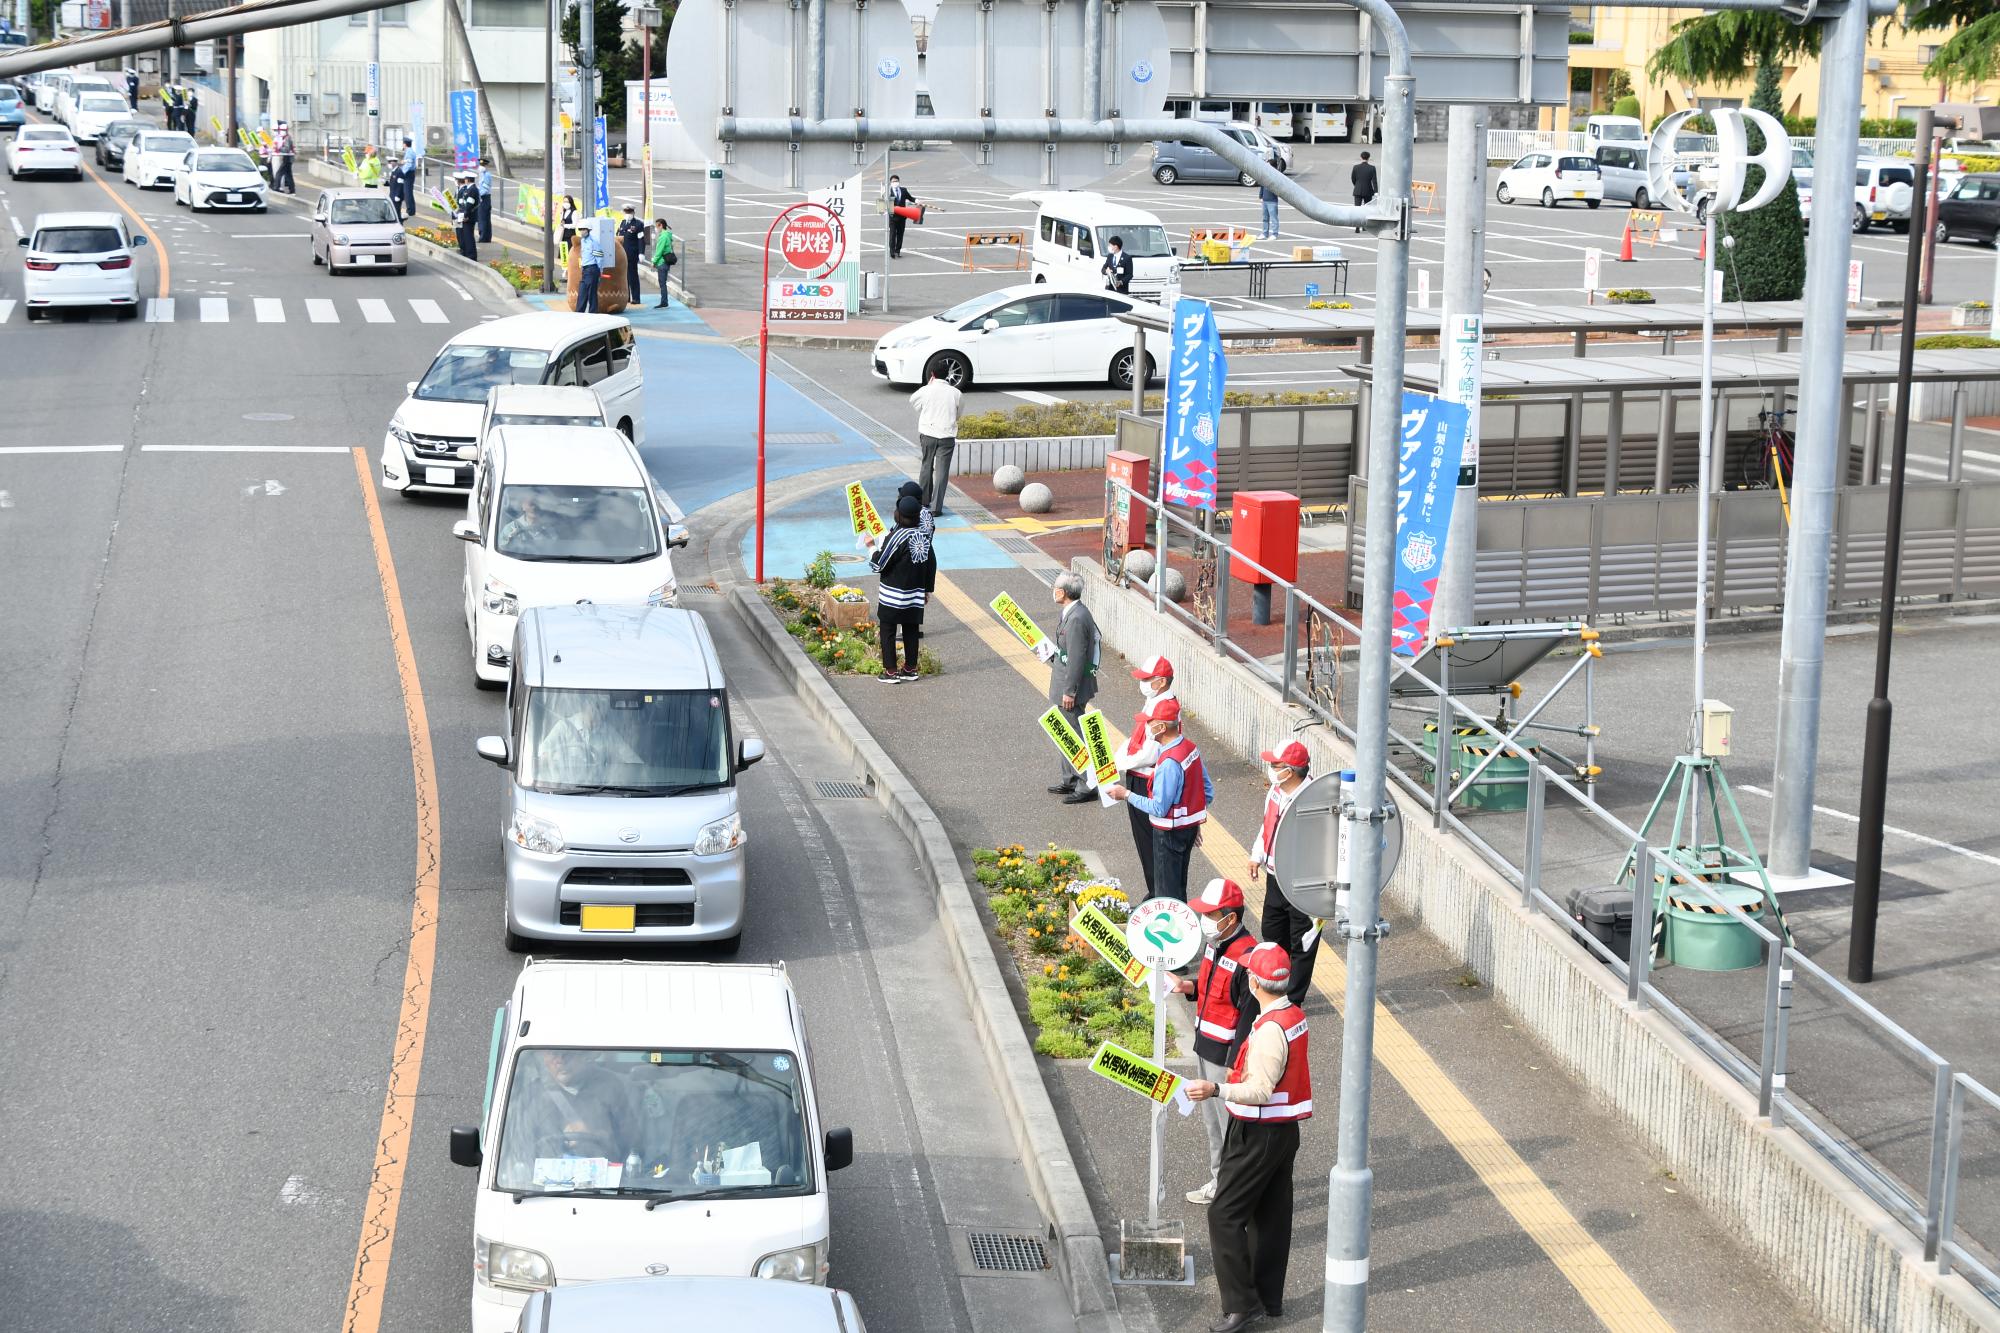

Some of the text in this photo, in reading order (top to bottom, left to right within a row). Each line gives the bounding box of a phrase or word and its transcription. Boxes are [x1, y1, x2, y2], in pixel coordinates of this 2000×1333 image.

[786, 231, 830, 253] 消火栓
[1171, 313, 1206, 461] ヴァンフォーレ
[851, 484, 866, 532] 交通安全
[1045, 712, 1081, 756] 交通安全運動
[1085, 715, 1110, 767] 交通安全運動
[1080, 910, 1133, 965] 交通安全運動
[1131, 900, 1198, 931] 甲斐市民バス
[1099, 1050, 1159, 1090] 交通安全運動
